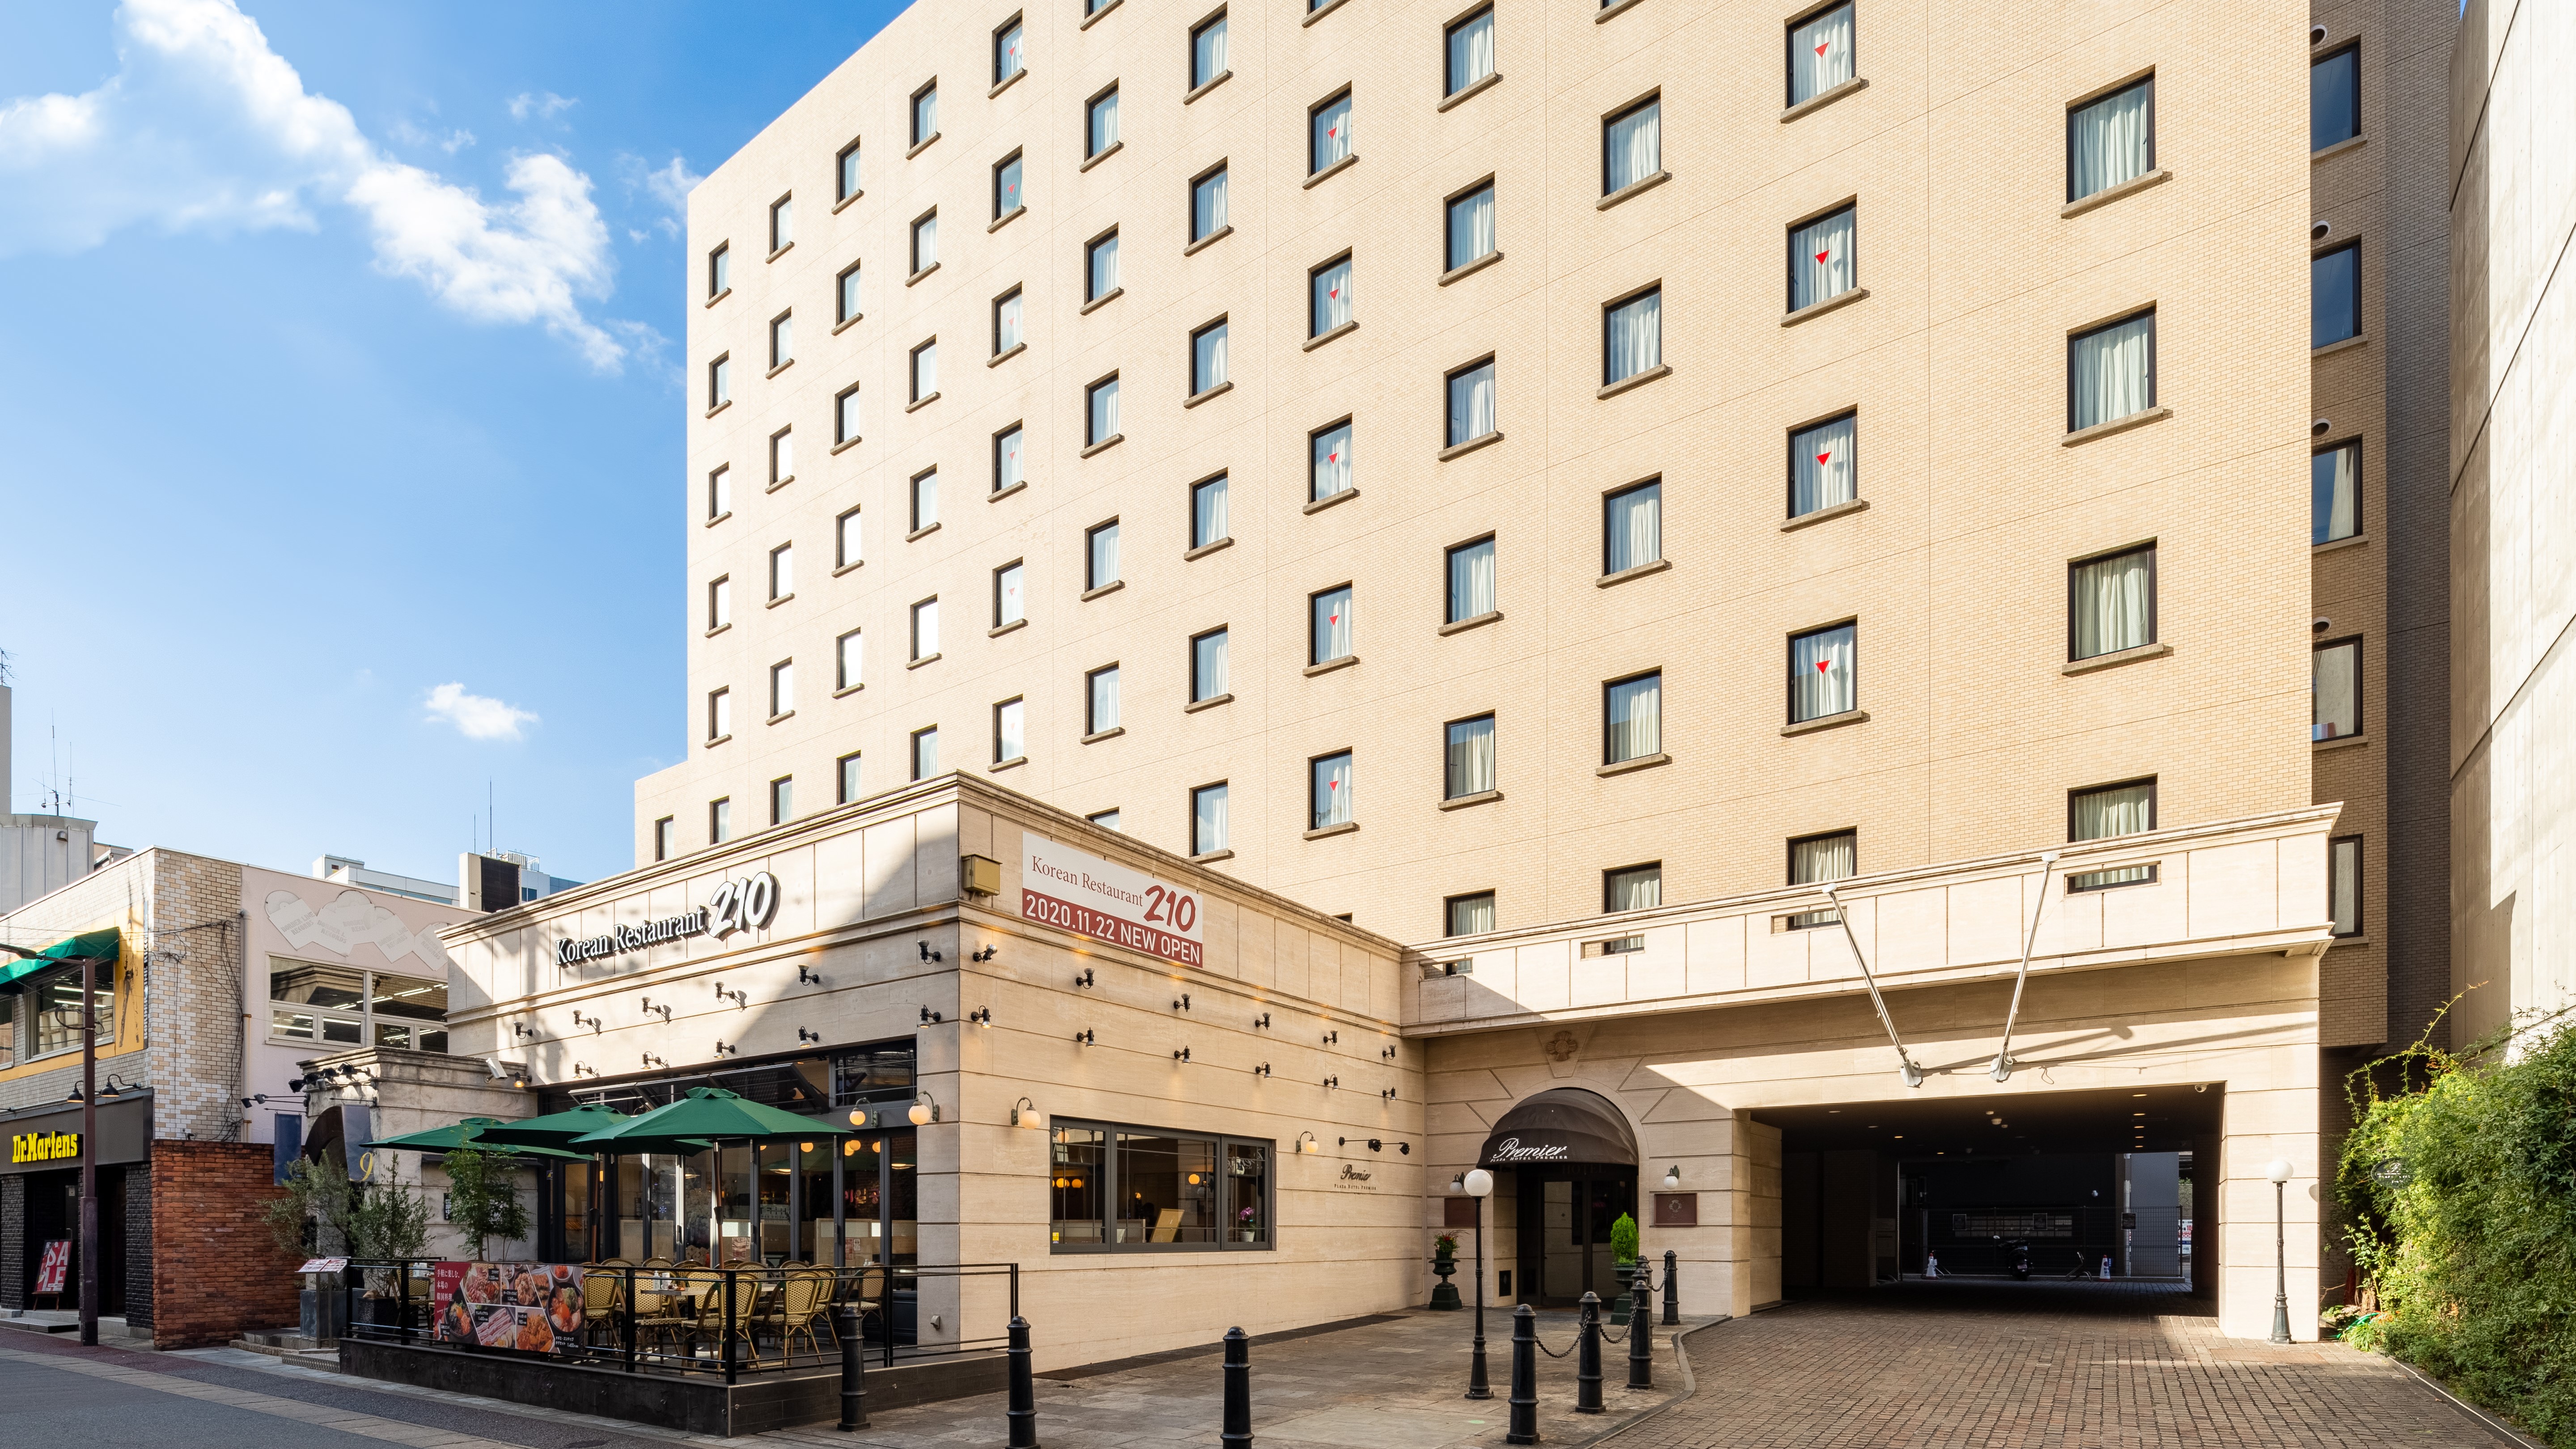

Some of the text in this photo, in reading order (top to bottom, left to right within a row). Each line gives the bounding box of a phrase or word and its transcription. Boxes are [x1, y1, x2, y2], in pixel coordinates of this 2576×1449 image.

[1032, 855, 1196, 932] Korean Restaurant 210
[291, 920, 314, 935] RECORDS
[555, 872, 775, 966] Korean Restaurant 210
[1026, 894, 1200, 965] 2020.11.22 NEW OPEN
[1493, 1138, 1568, 1159] Premier
[1340, 1164, 1372, 1181] Premier
[1563, 1164, 1607, 1174] HOTEL
[436, 1280, 448, 1289] 本場の
